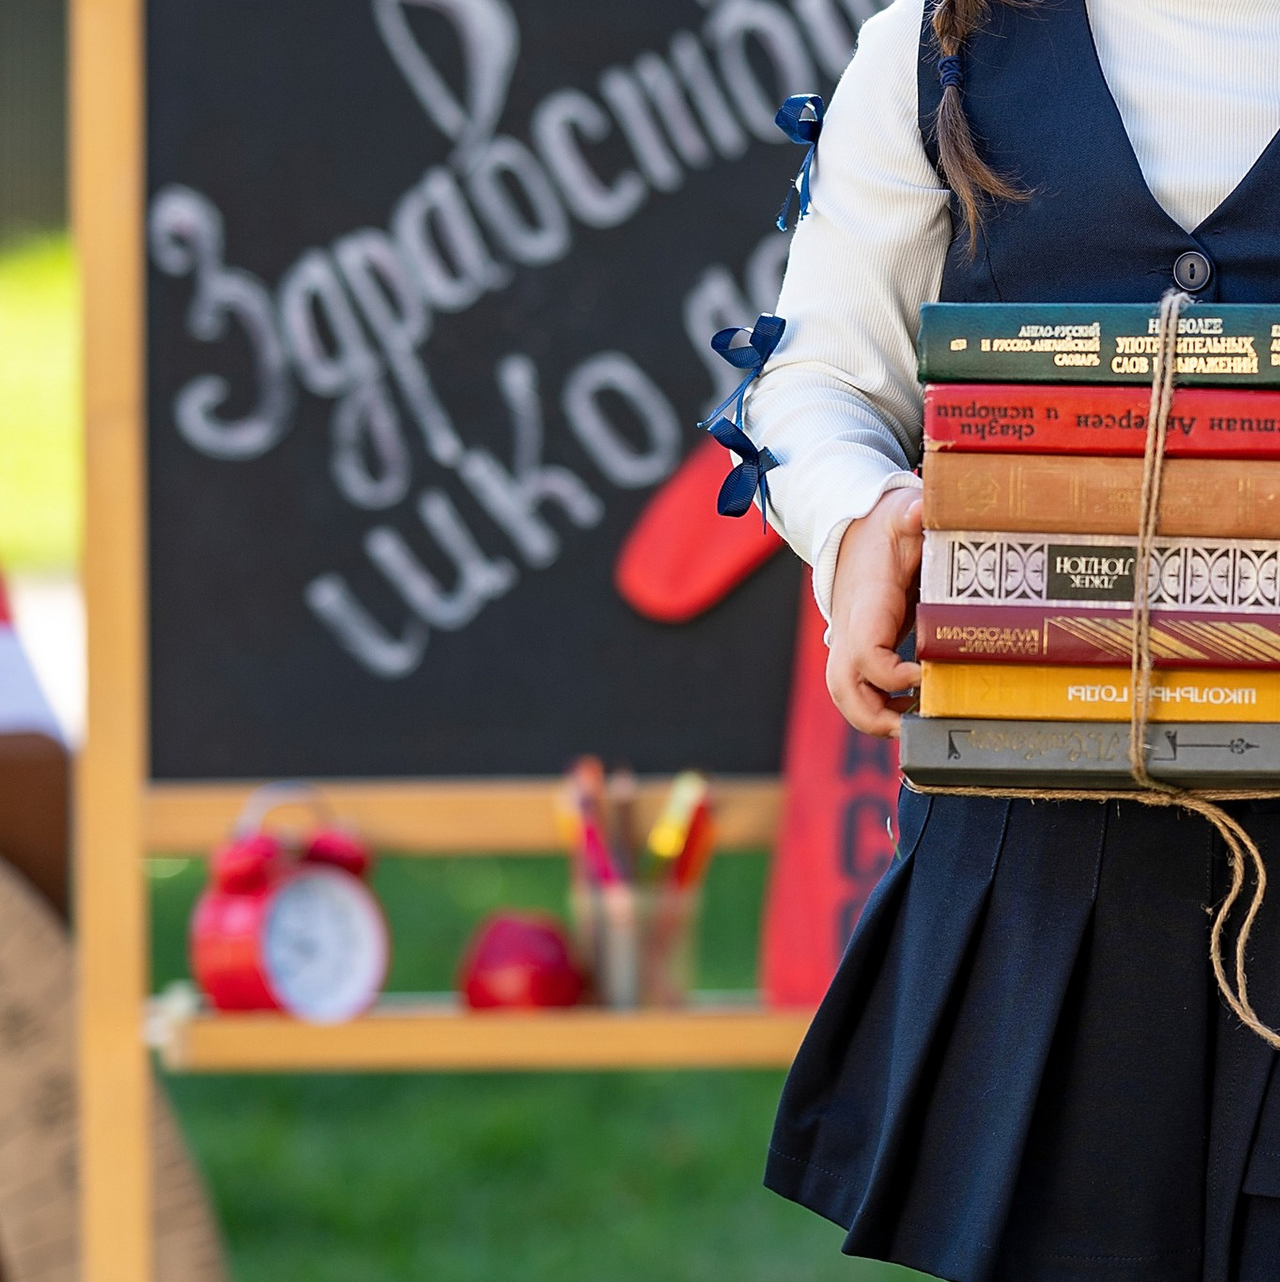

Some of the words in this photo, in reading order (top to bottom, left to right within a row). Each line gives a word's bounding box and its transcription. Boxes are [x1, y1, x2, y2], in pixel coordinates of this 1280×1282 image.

[1148, 318, 1223, 334] НБОЛЕЕ
[1115, 337, 1256, 355] УПОТРИТЕЛЬНЫХ
[1054, 353, 1101, 366] СЛОВАРЬ
[1111, 356, 1150, 373] СЛОВ
[936, 403, 1034, 421] истории
[1045, 407, 1059, 421] и
[960, 418, 1035, 442] сказки
[1076, 409, 1196, 436] Анерсен
[303, 229, 790, 679] школ
[1055, 557, 1135, 575] ЛОНДОН
[1070, 575, 1118, 589] ДЖЕК
[1068, 684, 1129, 703] ГОДЫ
